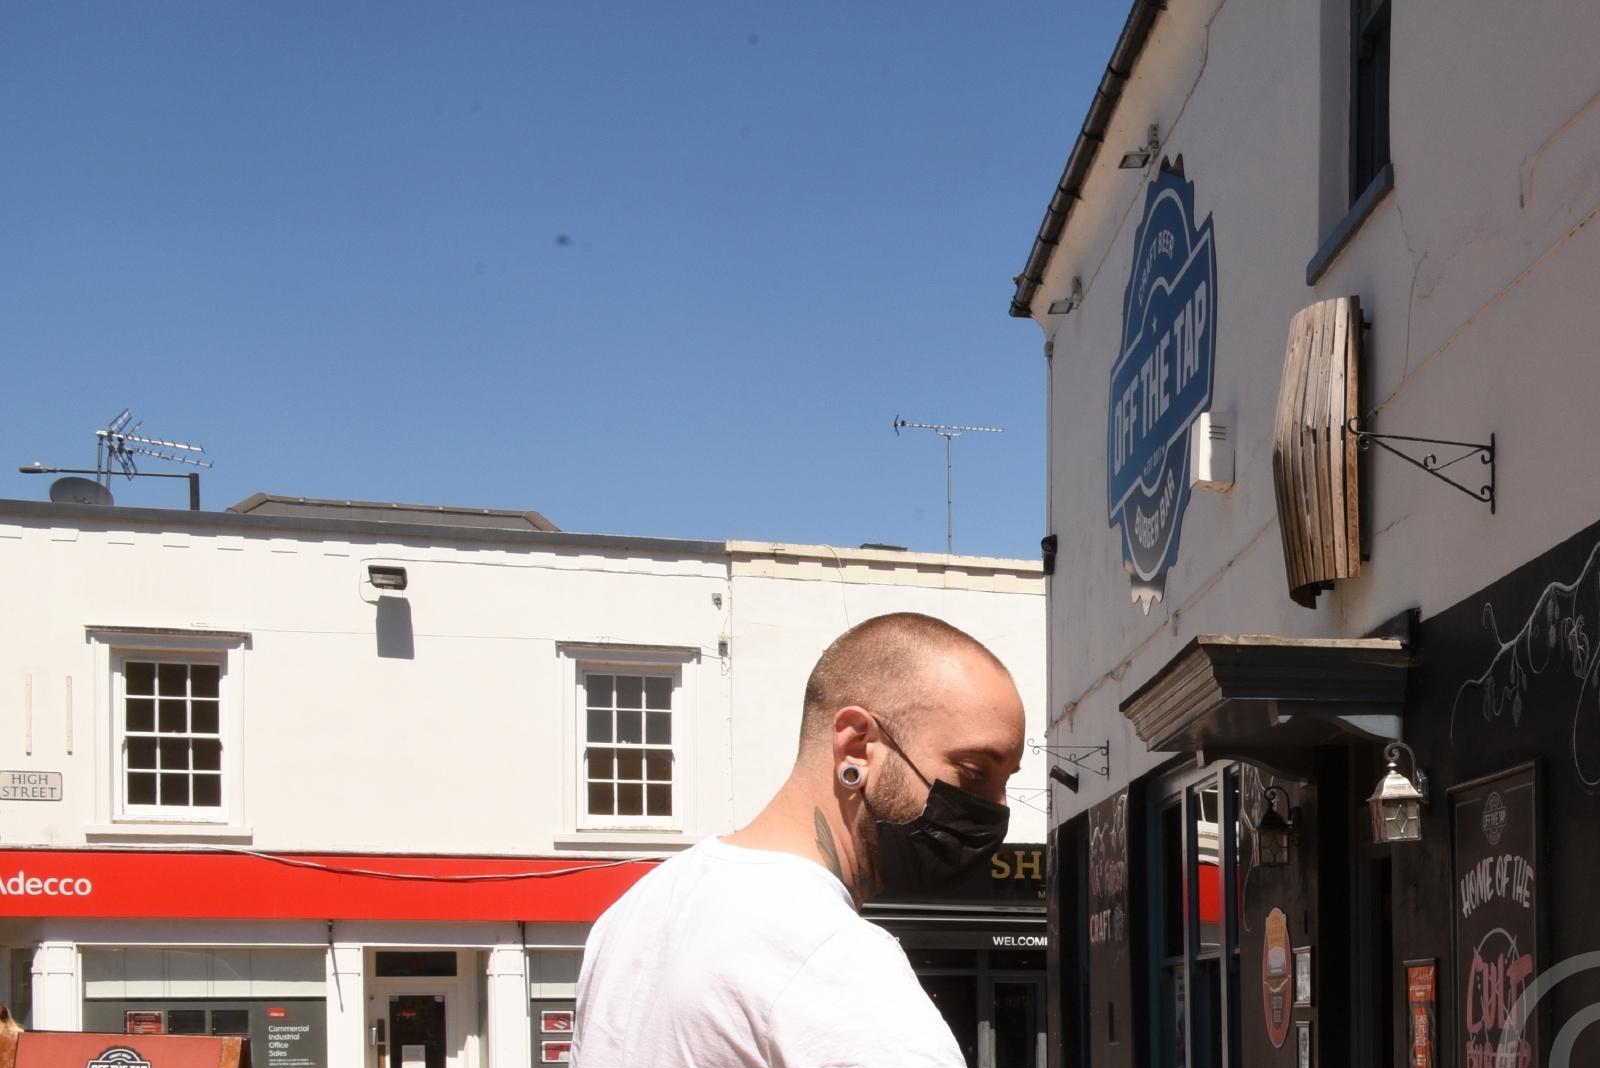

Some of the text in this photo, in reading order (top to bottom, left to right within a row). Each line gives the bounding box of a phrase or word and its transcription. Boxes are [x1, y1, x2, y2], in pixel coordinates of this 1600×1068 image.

[1113, 374, 1139, 477] OFF
[1140, 329, 1170, 440] THE
[1173, 279, 1207, 396] TAP
[2, 786, 57, 799] STREET
[11, 773, 49, 785] HIGH
[1461, 854, 1534, 918] HOME OF THE
[1466, 952, 1533, 1034] CULT
[268, 1041, 289, 1049] Office
